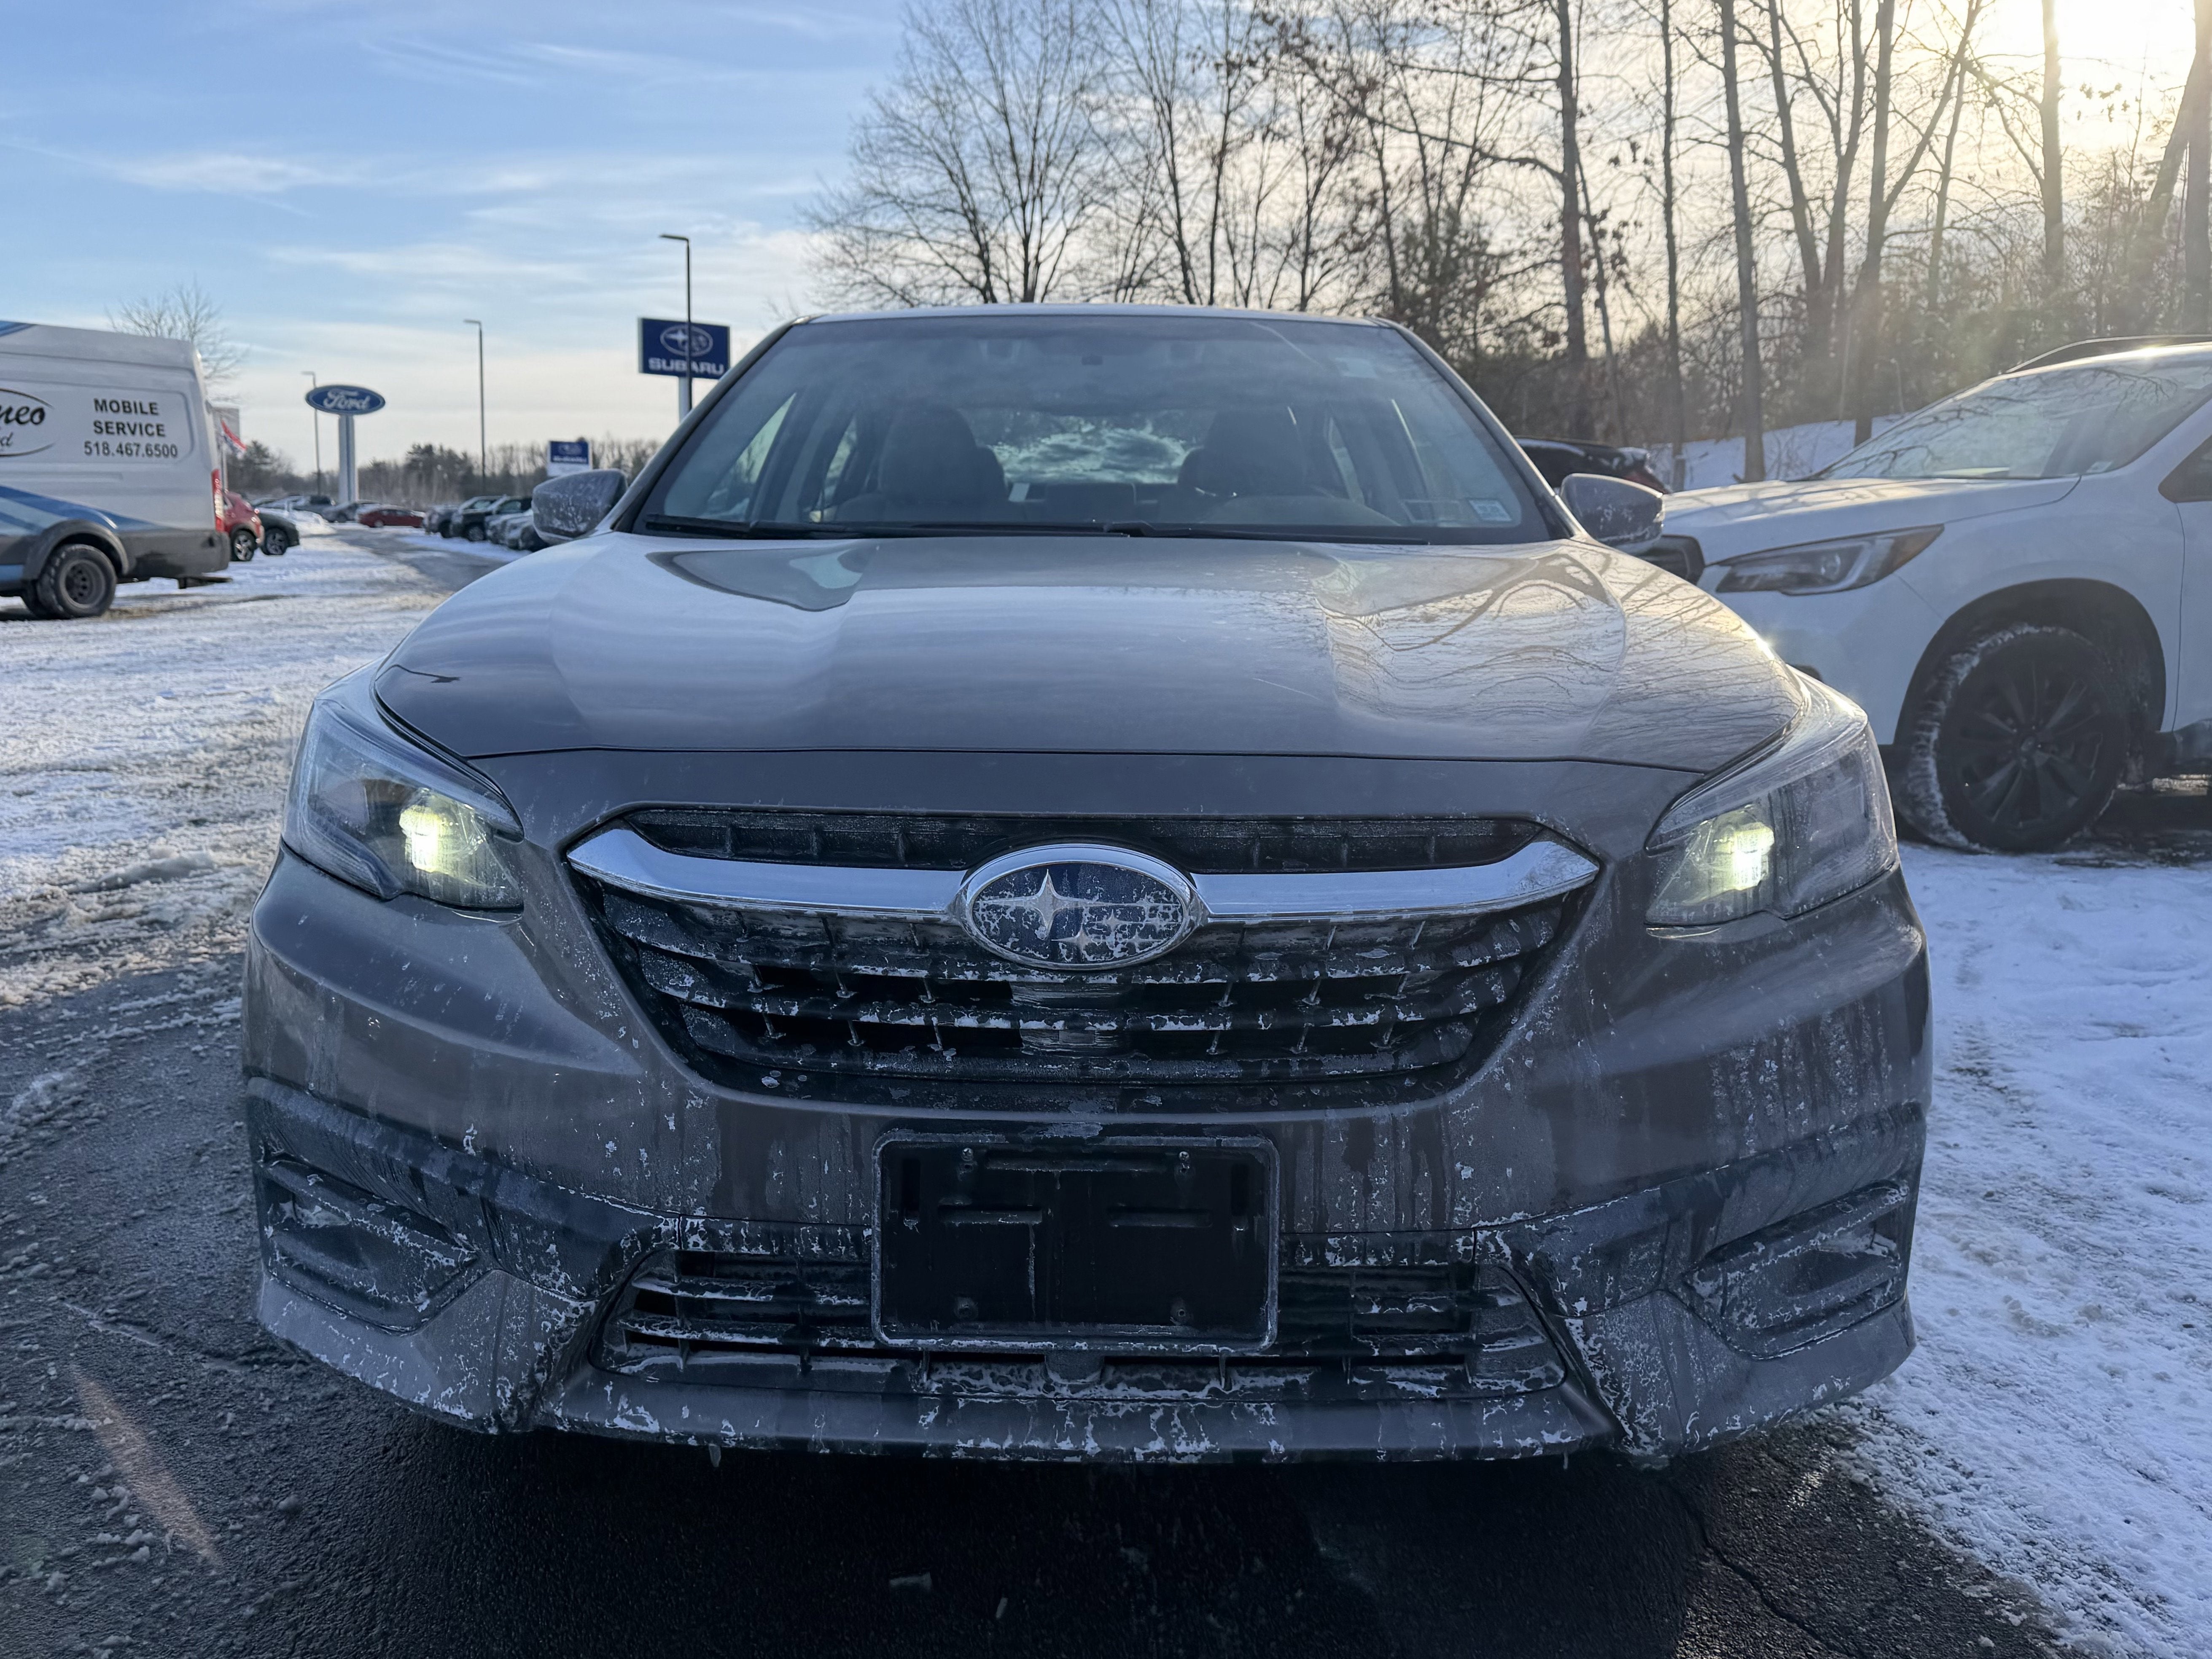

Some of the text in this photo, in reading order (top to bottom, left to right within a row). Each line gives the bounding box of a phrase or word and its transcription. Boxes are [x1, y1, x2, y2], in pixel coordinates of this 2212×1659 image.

[648, 358, 724, 374] SUBARU
[94, 398, 158, 415] MOBILE
[323, 389, 370, 409] Ford
[94, 420, 166, 437] SERVICE
[84, 441, 178, 458] 518.467.6500
